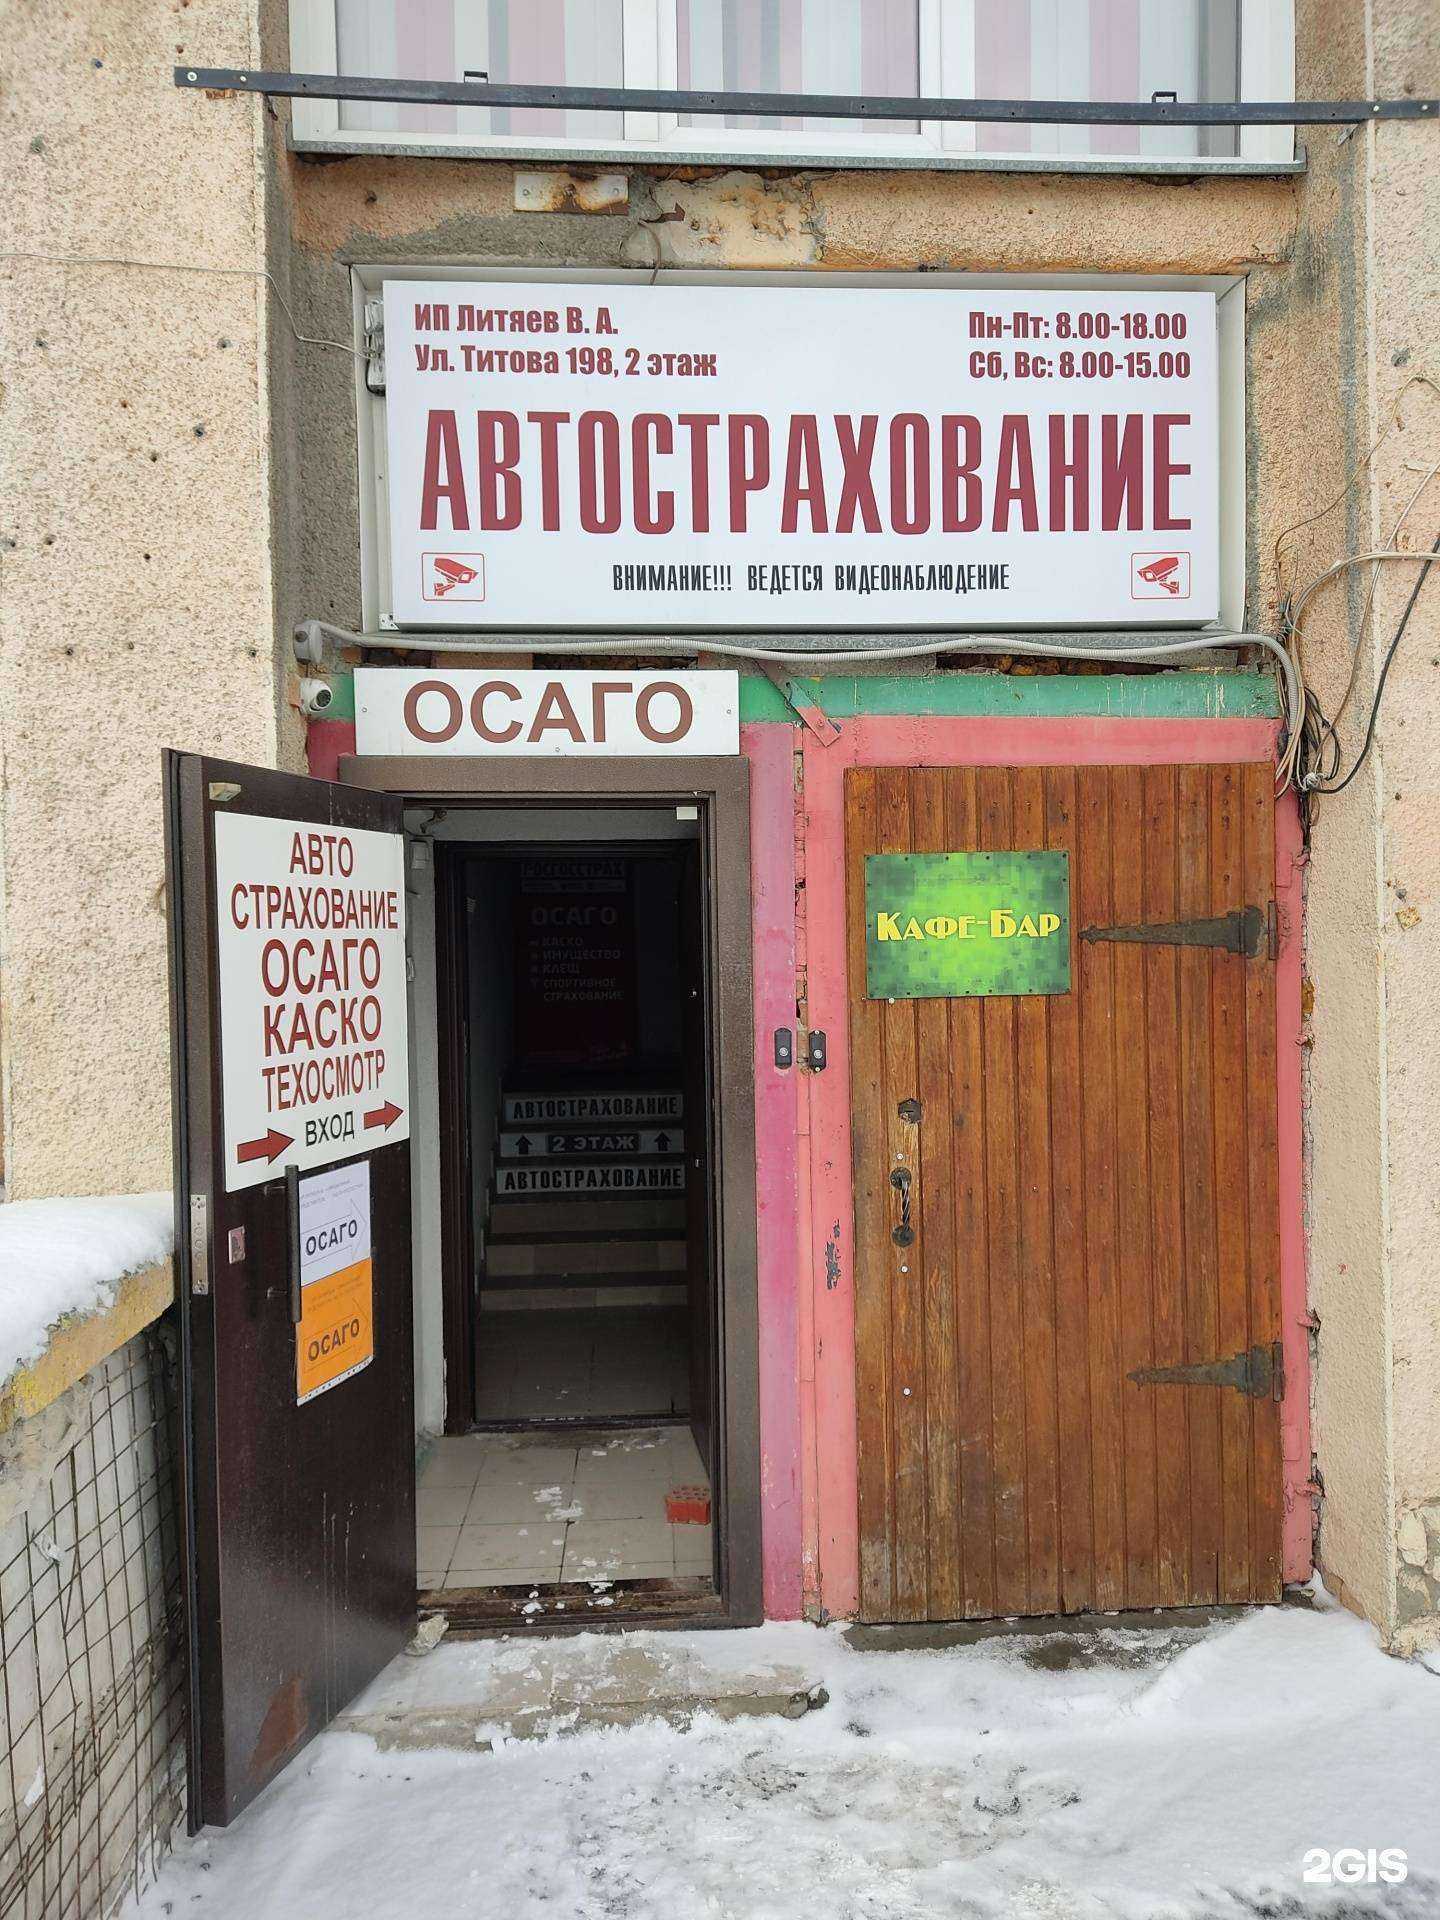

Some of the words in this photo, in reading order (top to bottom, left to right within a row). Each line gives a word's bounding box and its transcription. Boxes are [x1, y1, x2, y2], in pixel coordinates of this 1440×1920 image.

[415, 304, 450, 331] ИП
[456, 305, 559, 333] Литяев
[567, 307, 590, 334] В.
[595, 307, 618, 334] А.
[969, 312, 1050, 339] Пн-Пт:
[1056, 312, 1187, 340] 8.00-18.00
[415, 344, 455, 372] Ул.
[461, 345, 559, 374] Титова
[566, 348, 619, 378] 198,
[625, 349, 640, 376] 2
[647, 353, 717, 376] этаж
[969, 351, 1008, 381] Сб,
[1014, 352, 1053, 378] Вс:
[1059, 352, 1191, 378] 8.00-15.00
[420, 410, 1191, 535] АВТОСТРАХОВАНИЕ
[613, 565, 732, 592] ВНИМАНИЕ!!!
[747, 564, 823, 594] ВЕДЕТСЯ
[835, 563, 1009, 595] ВИДЕОНАБЛЮДЕНИЕ
[403, 680, 694, 744] ОСАГО
[289, 831, 354, 878] АВТО
[231, 883, 398, 929] СТРАХОВАНИЕ
[531, 907, 617, 925] ОСАГО
[261, 937, 381, 997] ОСАГО
[264, 995, 381, 1057] КАСКО
[262, 1049, 385, 1113] ТЕХОСМОТР
[513, 1097, 677, 1120] АВТОСТРАХОВАНИЕ
[305, 1111, 355, 1147] ВХОД
[552, 1136, 565, 1151] 2
[574, 1136, 635, 1150] ЭТАЖ
[504, 1168, 681, 1191] АВТОСТРАХОВАНИЕ
[306, 1219, 358, 1256] ОСАГО
[308, 1318, 360, 1362] ОСАГО
